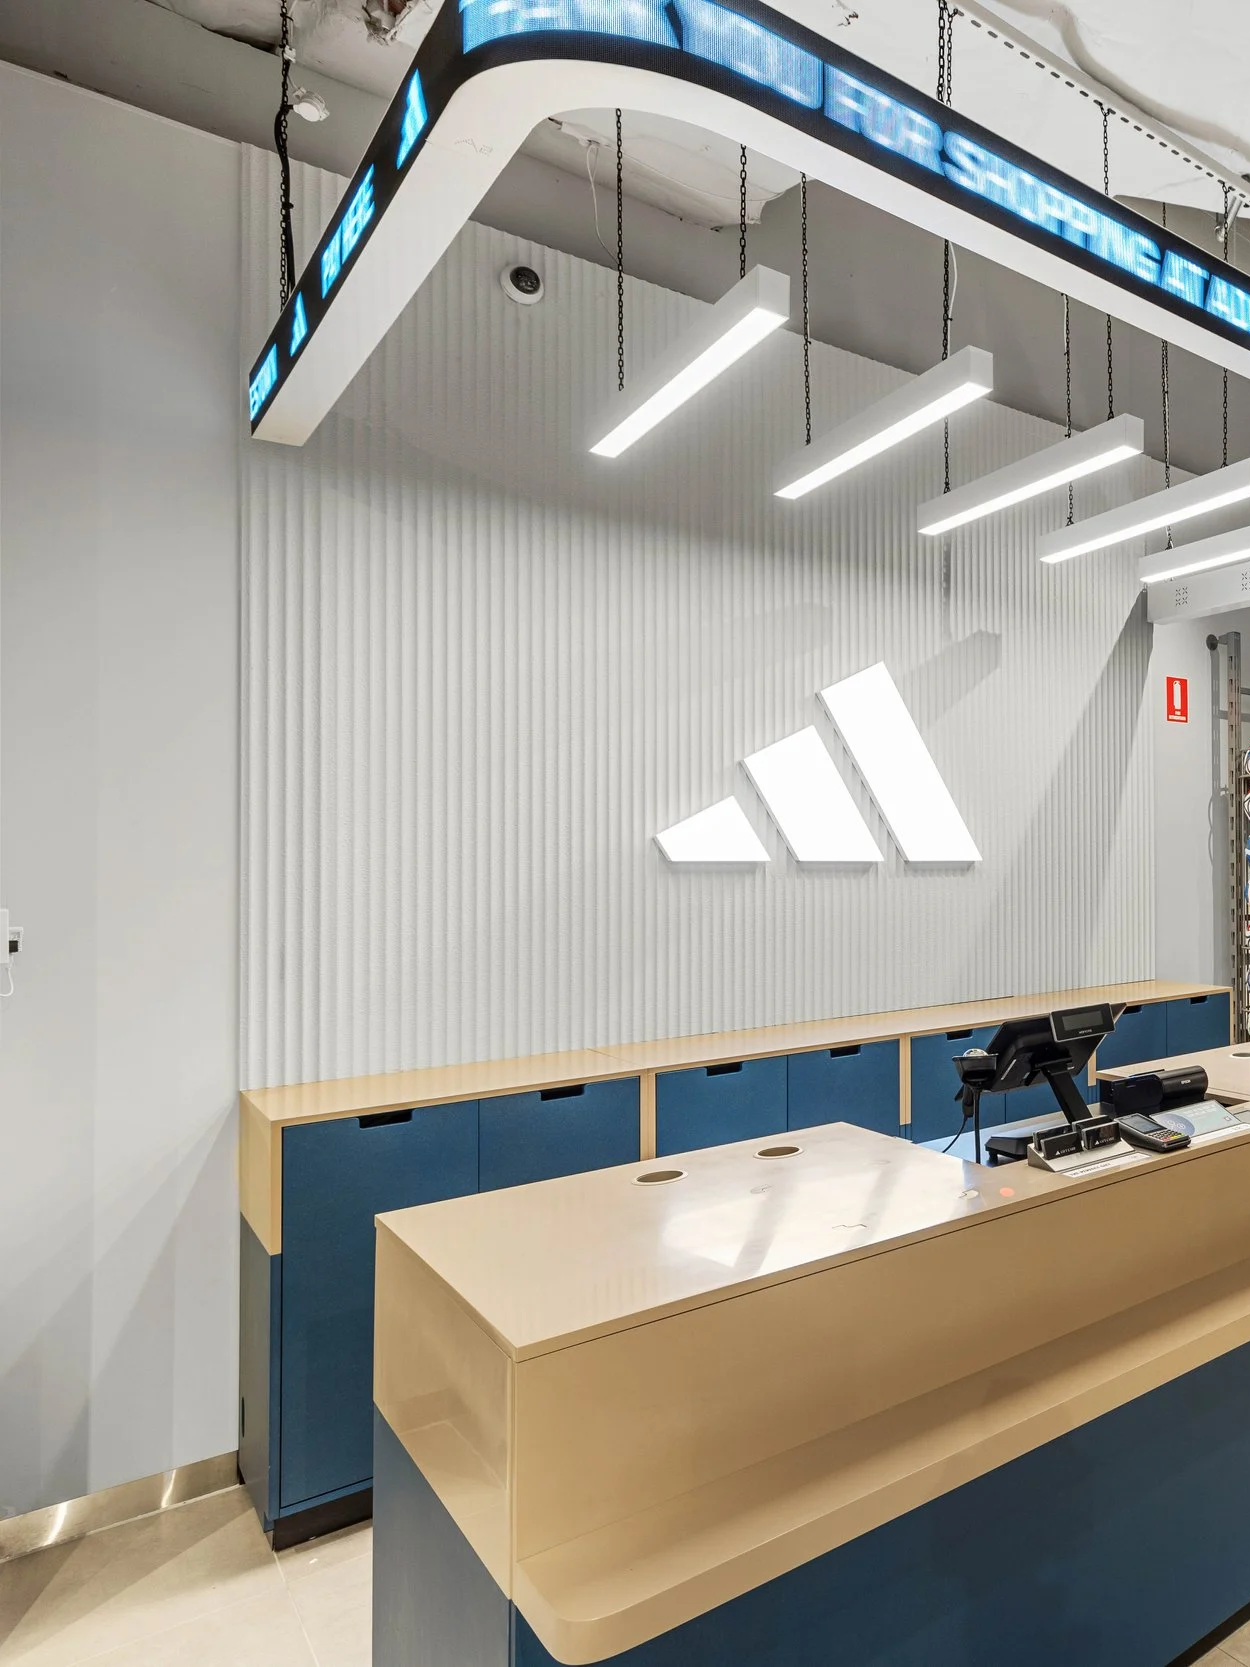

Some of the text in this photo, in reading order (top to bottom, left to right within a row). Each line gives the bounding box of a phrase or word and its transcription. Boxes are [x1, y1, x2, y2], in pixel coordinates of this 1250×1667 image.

[824, 63, 943, 176] FOR
[942, 130, 1161, 287] SHOPPING
[1161, 249, 1209, 311] AT
